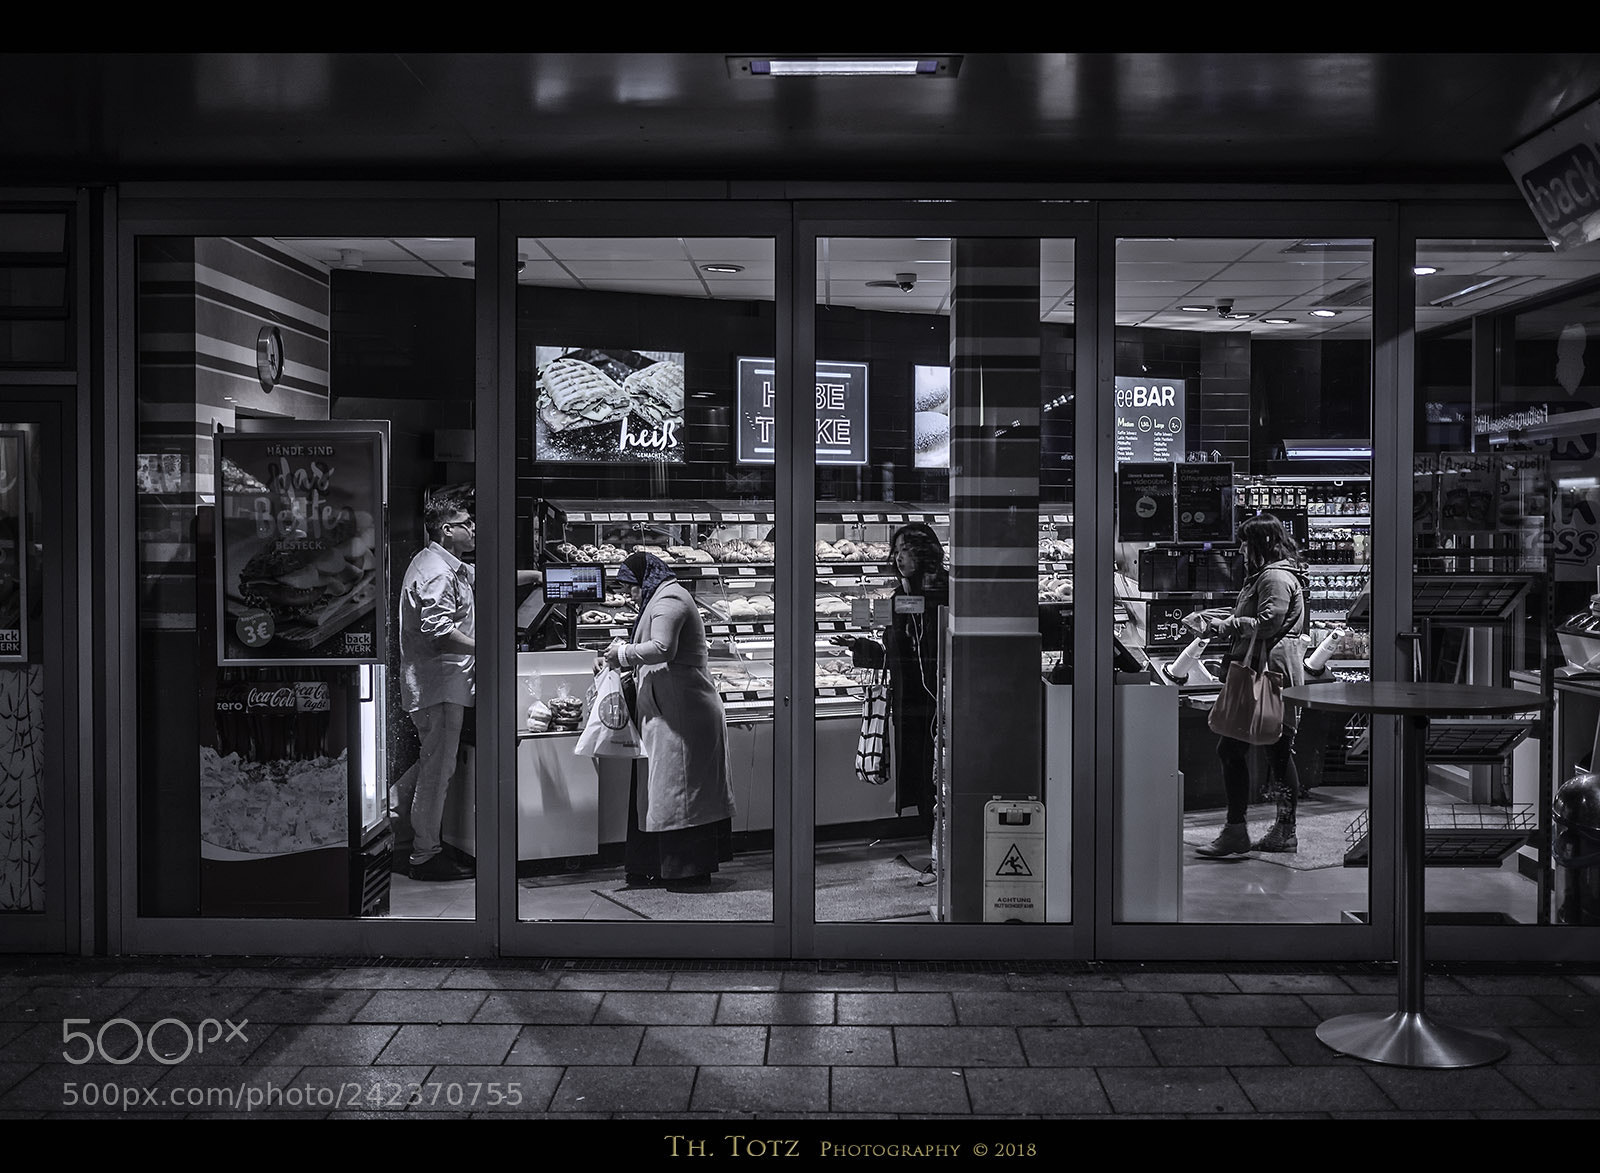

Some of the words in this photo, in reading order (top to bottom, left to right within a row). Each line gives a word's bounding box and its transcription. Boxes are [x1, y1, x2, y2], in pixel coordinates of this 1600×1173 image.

[1525, 153, 1600, 223] back
[763, 381, 845, 410] HBE
[620, 416, 678, 452] heiß
[755, 417, 851, 445] TKE
[267, 444, 303, 456] HÄNDE
[307, 446, 333, 456] SIND
[0, 630, 18, 641] ack
[347, 634, 370, 643] back
[0, 642, 20, 651] ERK
[345, 644, 371, 653] WERK
[216, 702, 243, 712] zero
